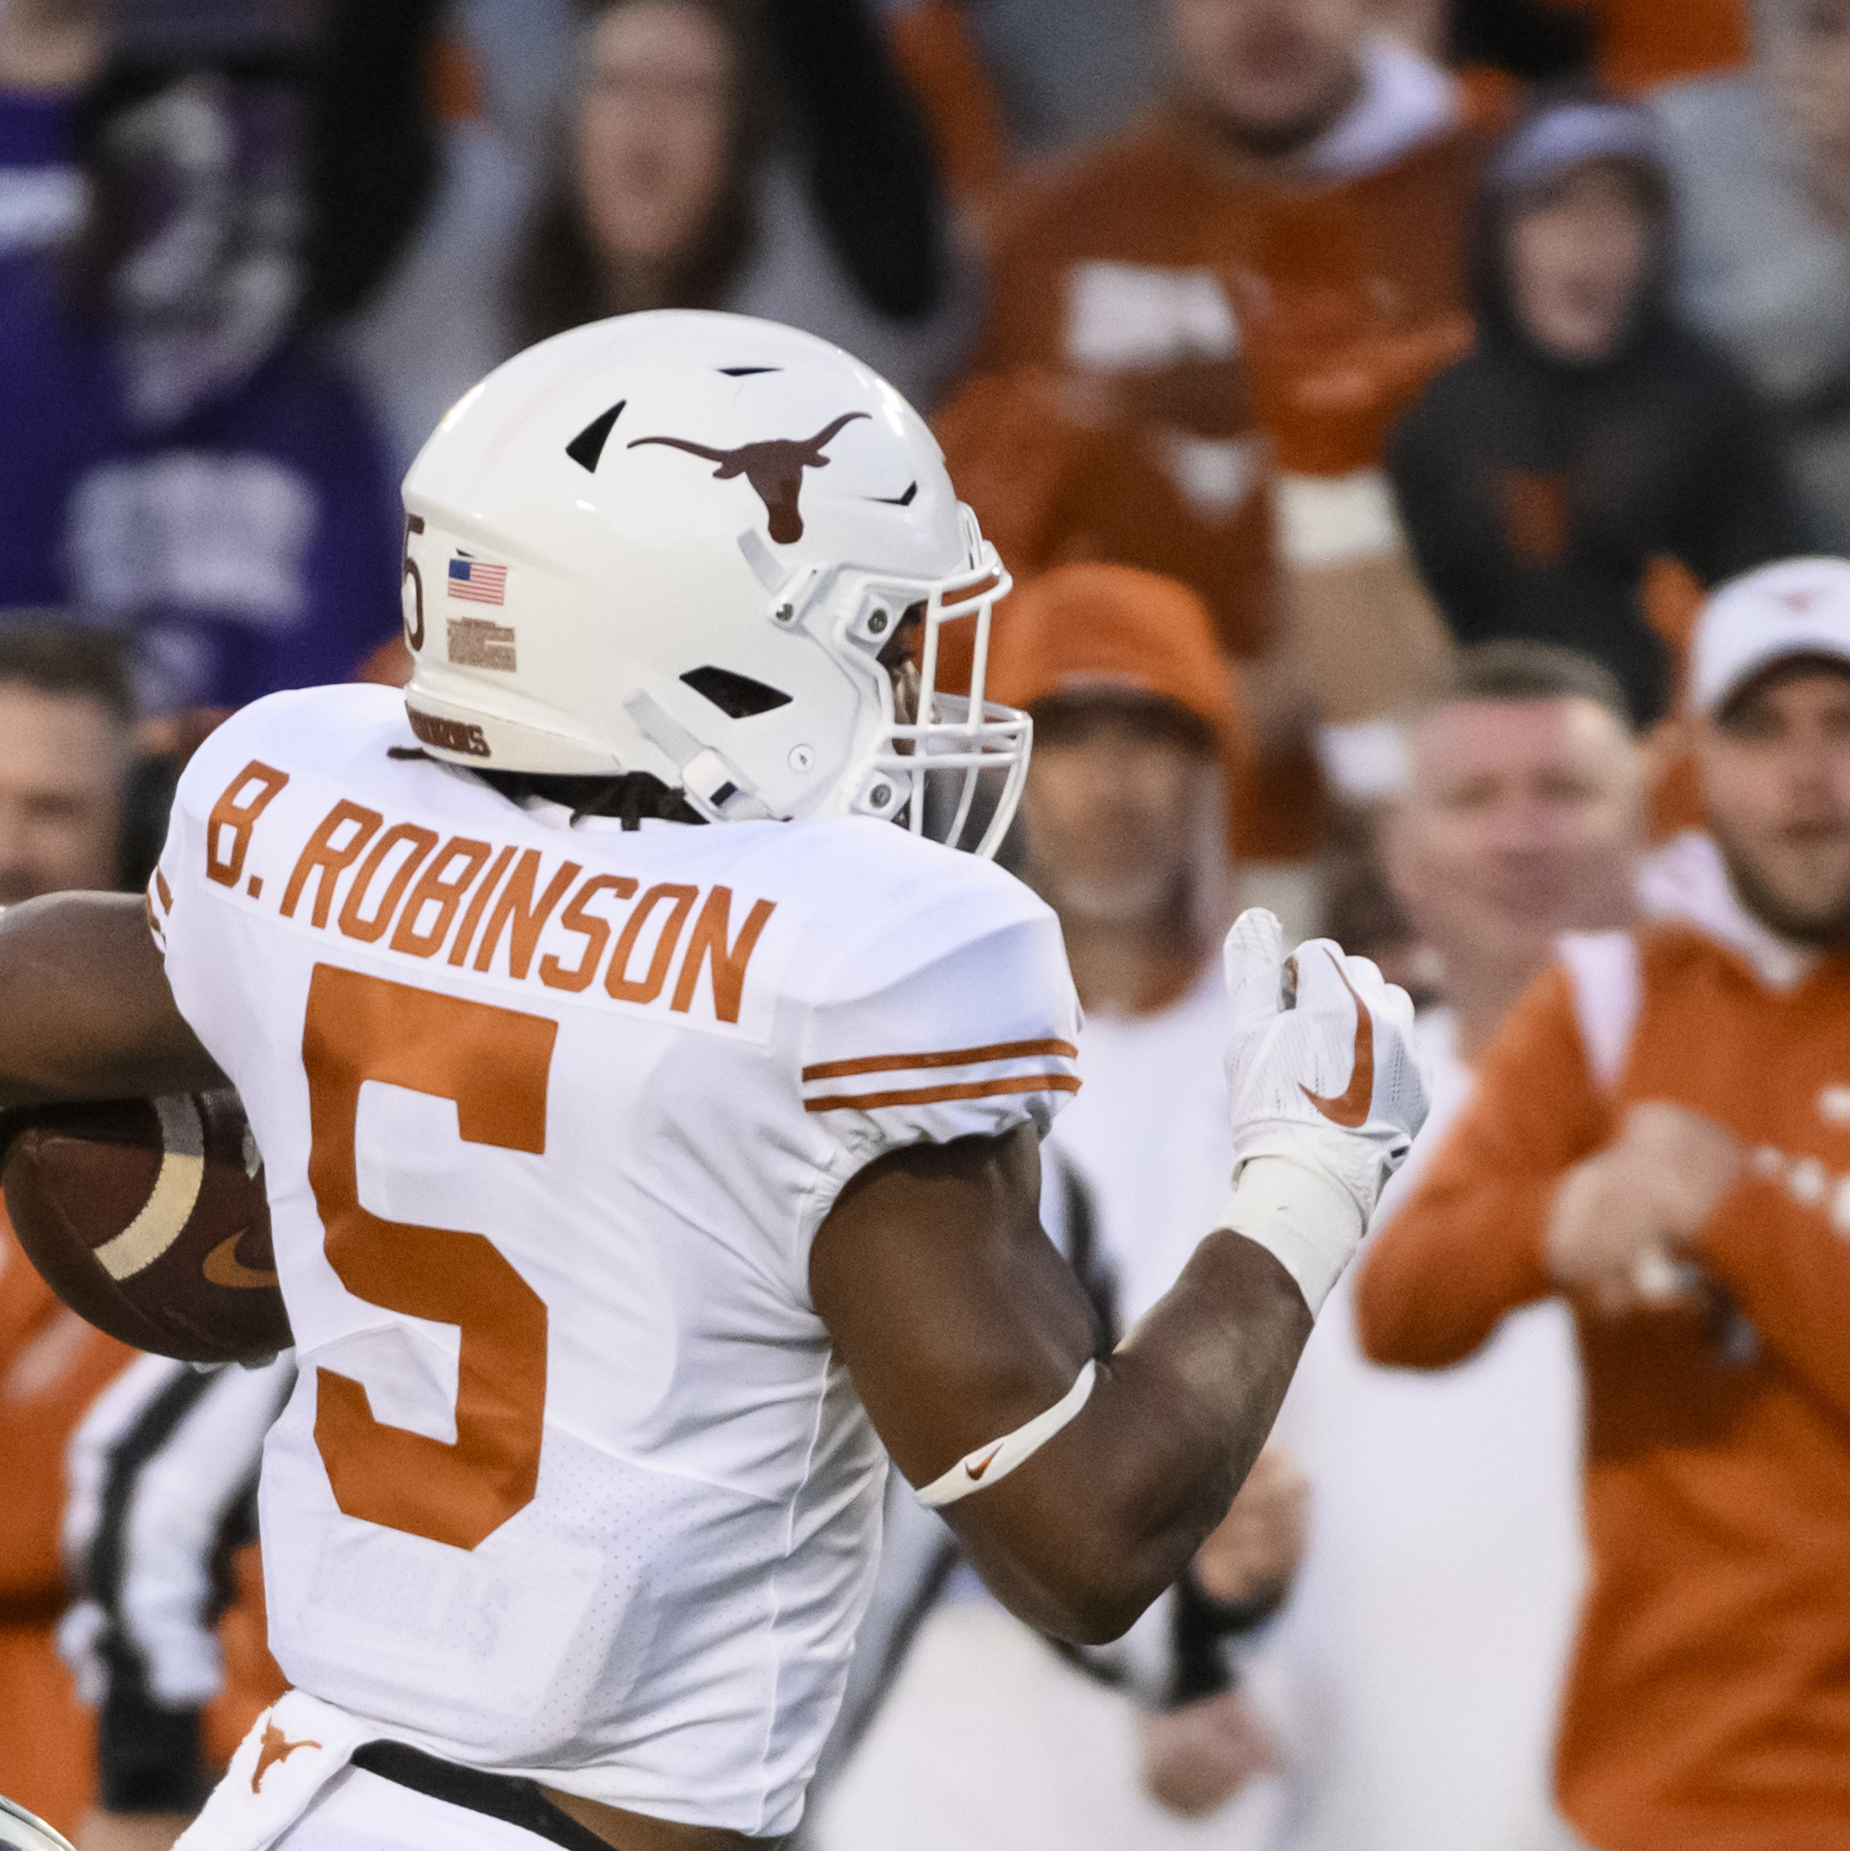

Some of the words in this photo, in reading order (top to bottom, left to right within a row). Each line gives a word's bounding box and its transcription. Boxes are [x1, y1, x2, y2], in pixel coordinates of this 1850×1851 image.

[206, 759, 289, 899] B.
[280, 798, 777, 1024] ROBINSON
[302, 962, 559, 1551] 5
